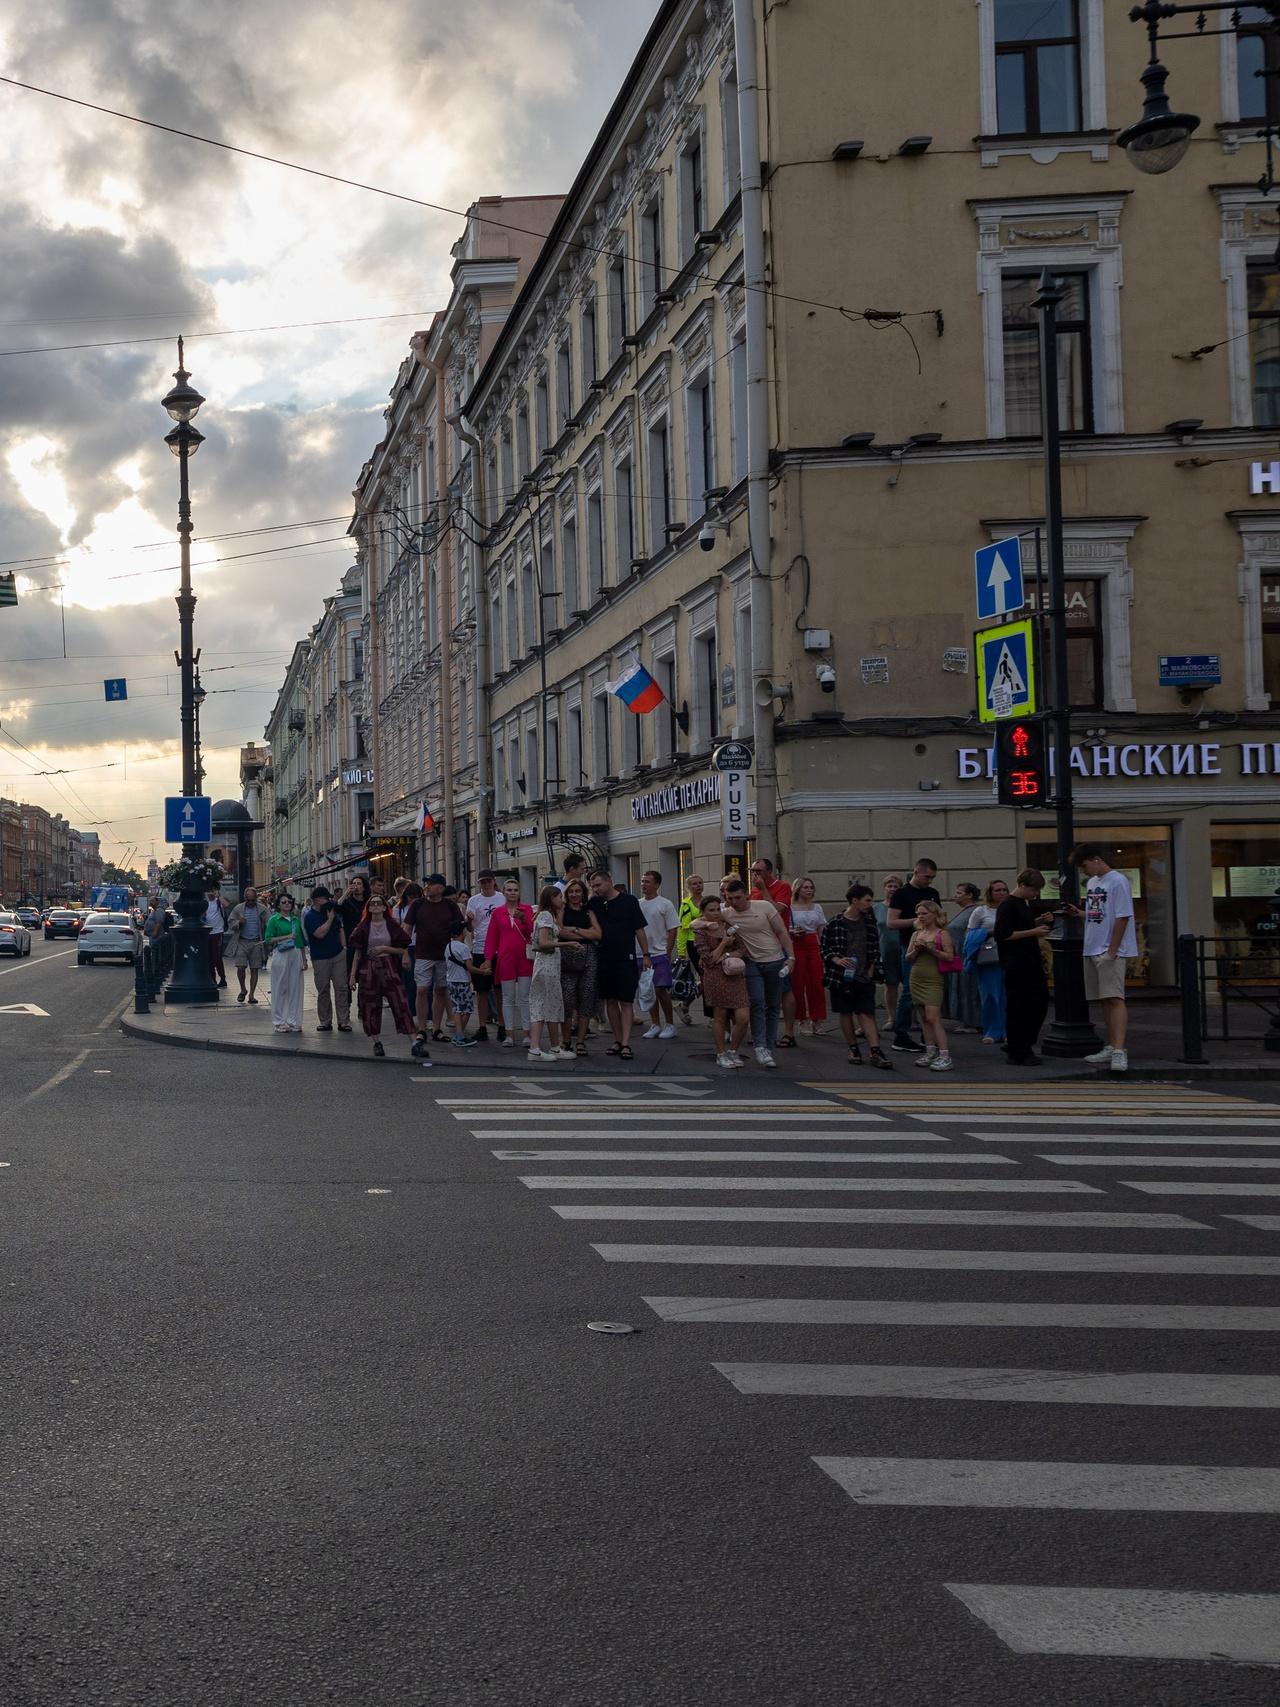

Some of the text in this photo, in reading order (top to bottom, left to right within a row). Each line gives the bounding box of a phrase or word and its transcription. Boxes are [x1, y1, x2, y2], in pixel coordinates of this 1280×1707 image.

[631, 775, 721, 820] БРИТАНСКИЕ ПЕКАРНИ
[729, 773, 741, 822] PUB
[1011, 771, 1038, 795] 36
